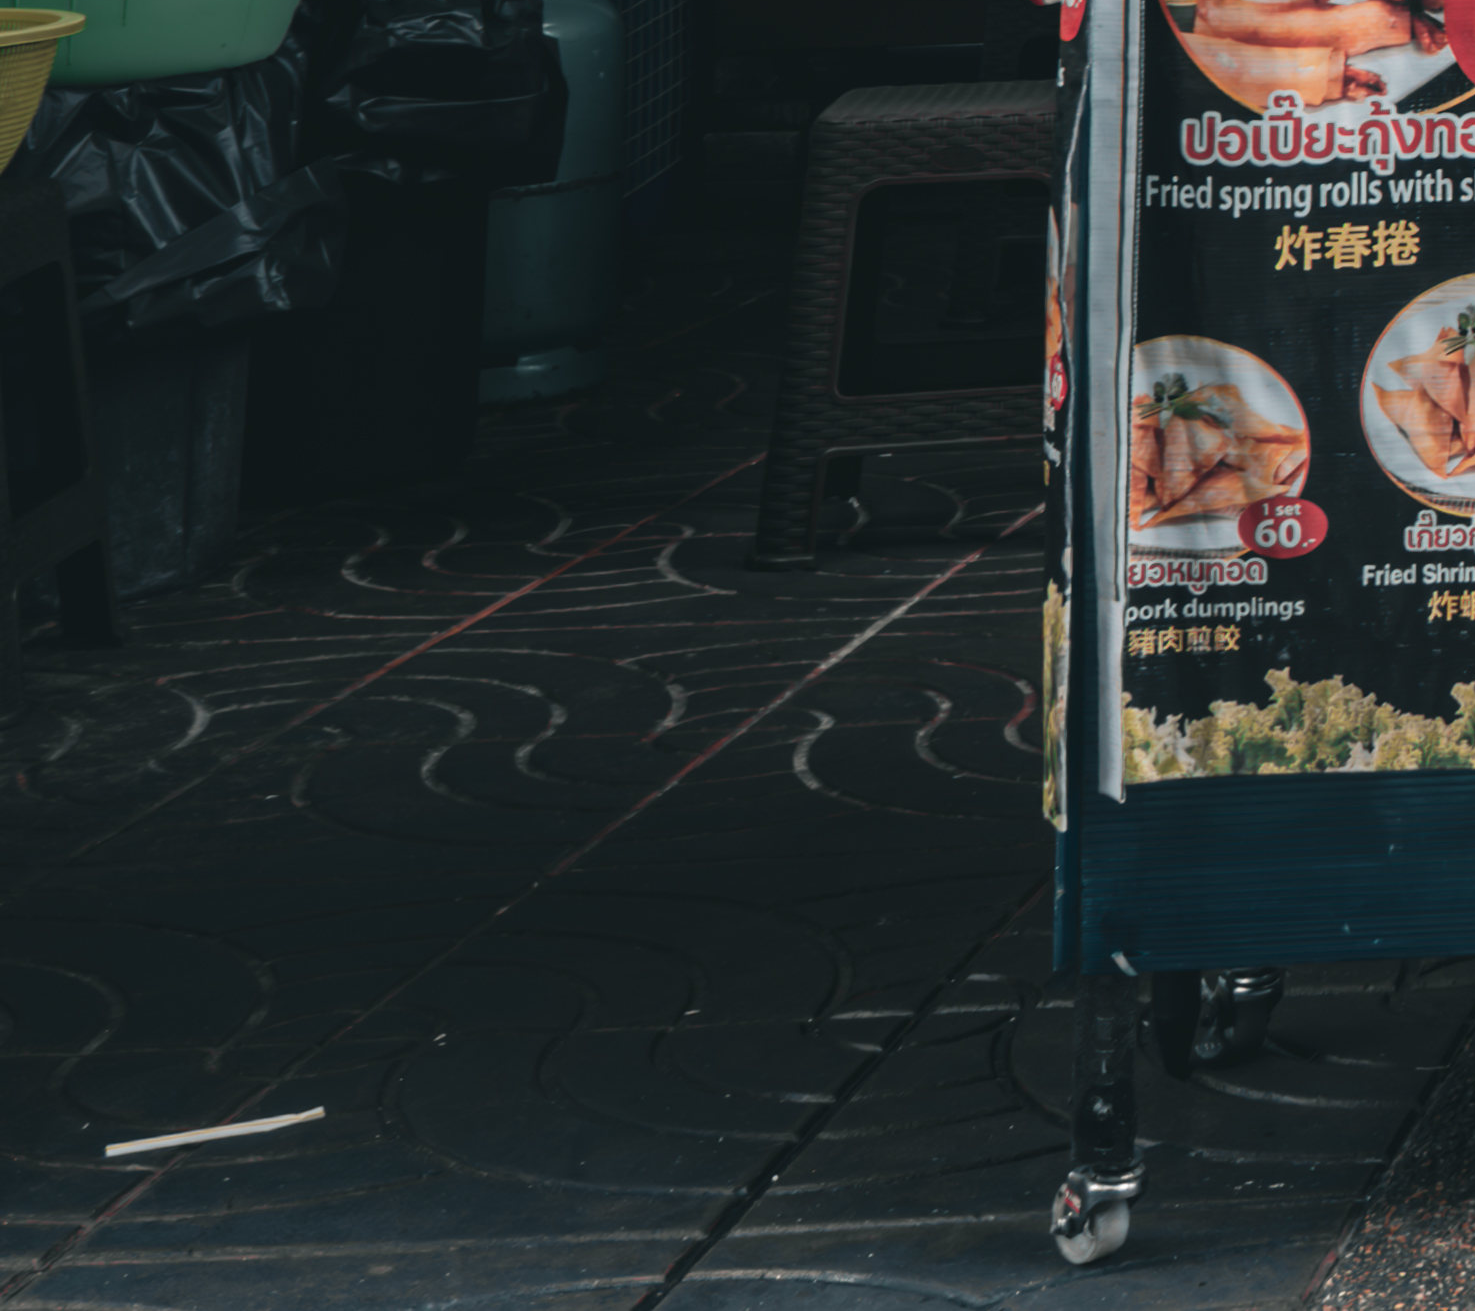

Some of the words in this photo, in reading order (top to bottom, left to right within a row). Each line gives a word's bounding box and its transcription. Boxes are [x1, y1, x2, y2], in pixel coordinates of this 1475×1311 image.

[1146, 175, 1212, 209] Fried
[1219, 178, 1312, 217] spring
[1320, 168, 1385, 207] rolls
[1385, 168, 1453, 203] with
[1275, 220, 1420, 270] 炸春捲
[1362, 564, 1416, 586] Fried
[1183, 597, 1304, 621] dumplings
